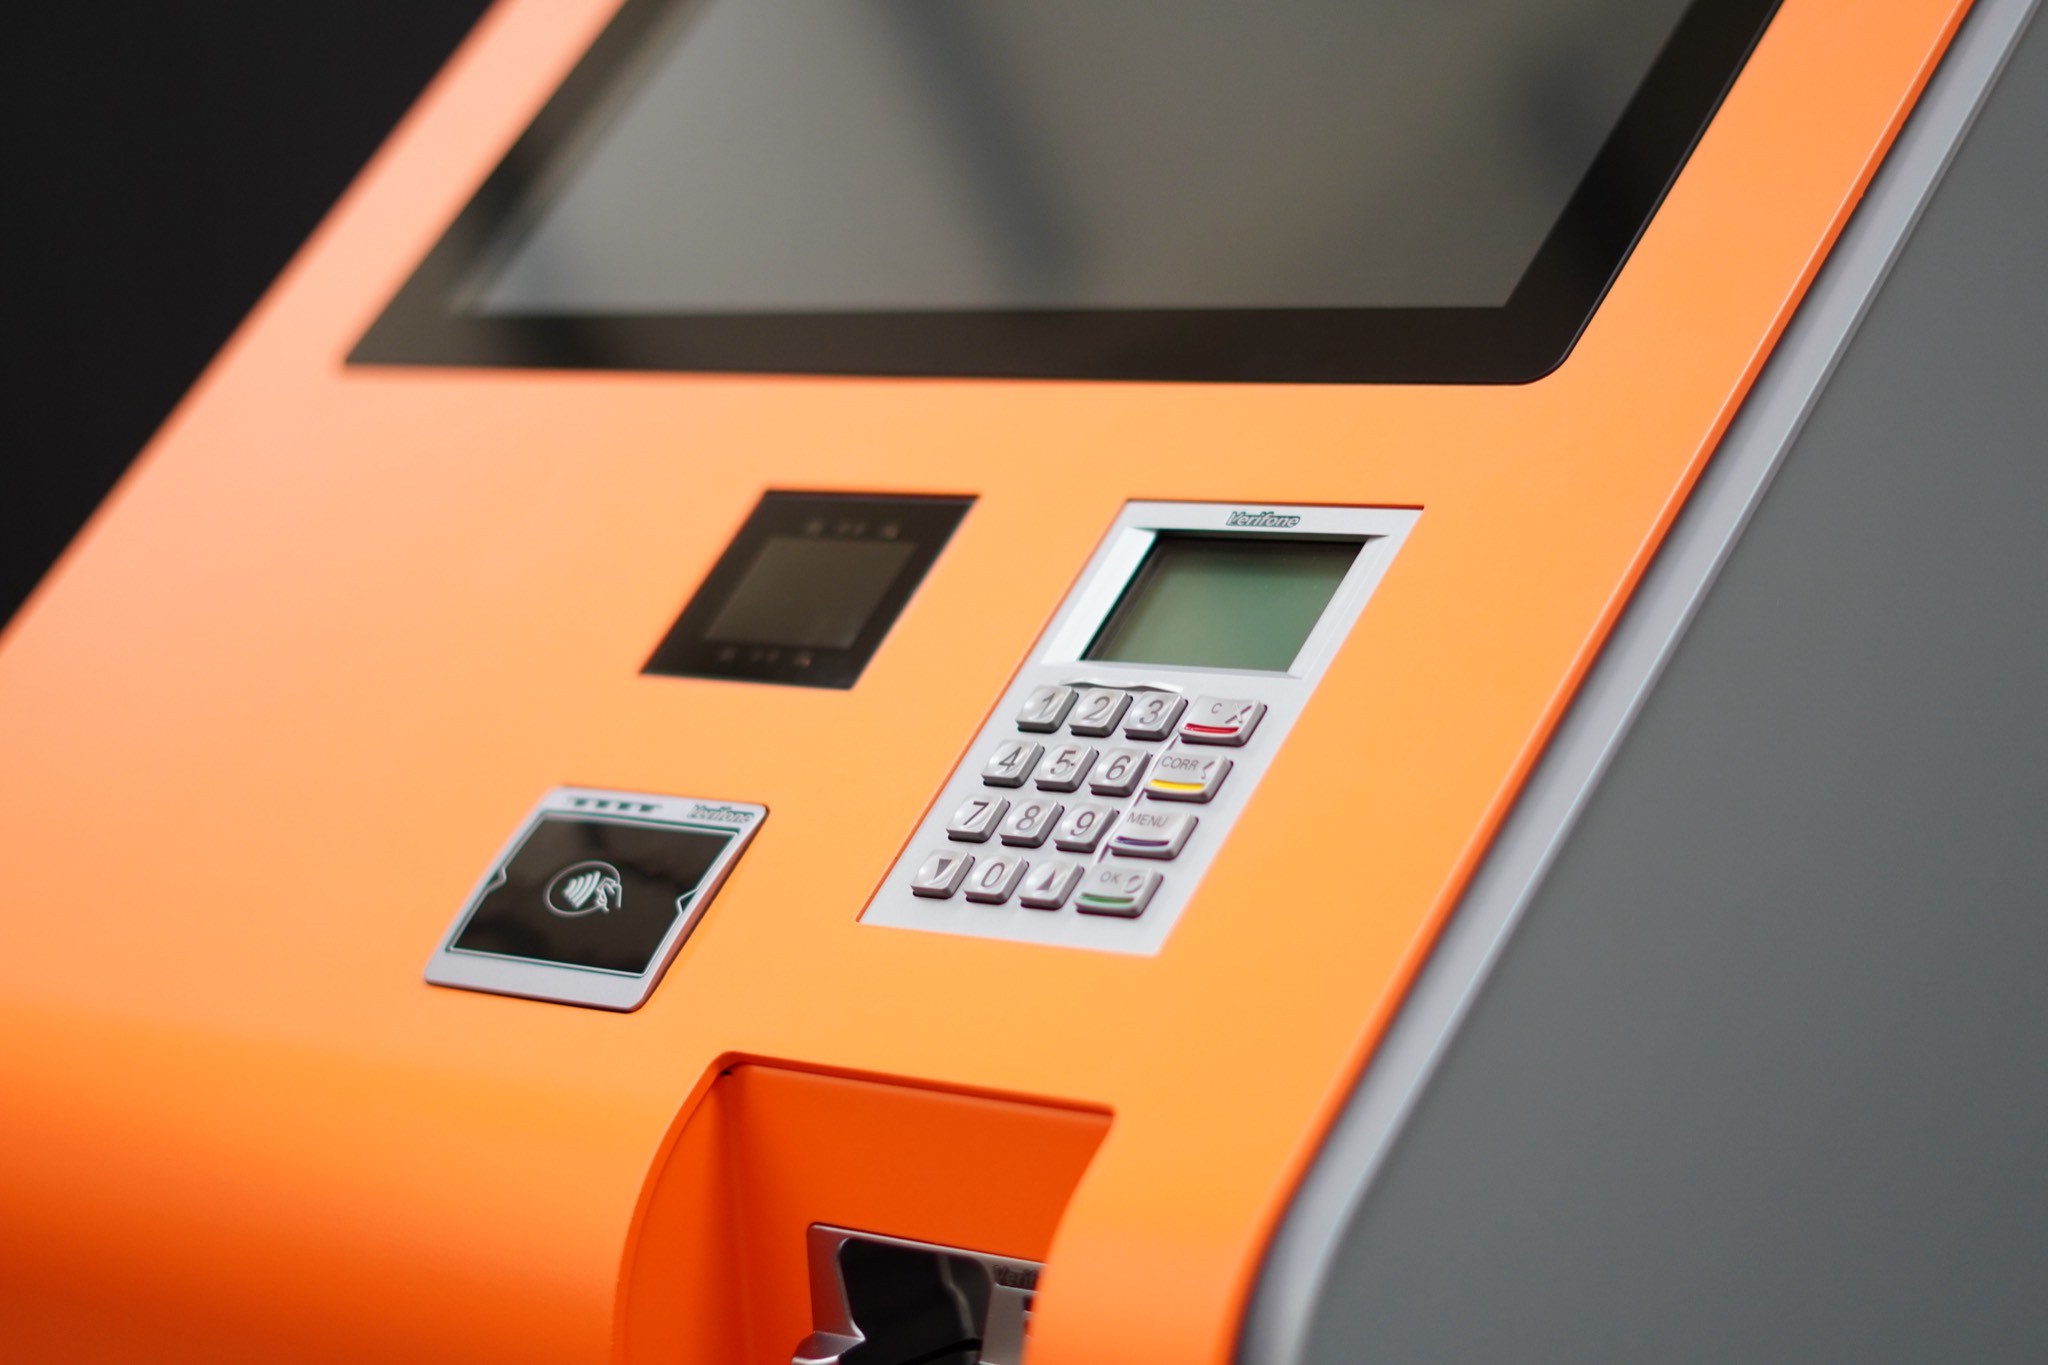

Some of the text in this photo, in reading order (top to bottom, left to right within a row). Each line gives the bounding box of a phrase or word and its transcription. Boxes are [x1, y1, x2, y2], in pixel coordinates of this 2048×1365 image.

[1225, 511, 1301, 528] Verifone
[1037, 692, 1222, 724] 1 2 3 C
[998, 746, 1199, 781] 4 5 6 CORR
[963, 801, 1168, 836] 7 8 9 MENU
[981, 862, 1121, 888] 0 OK
